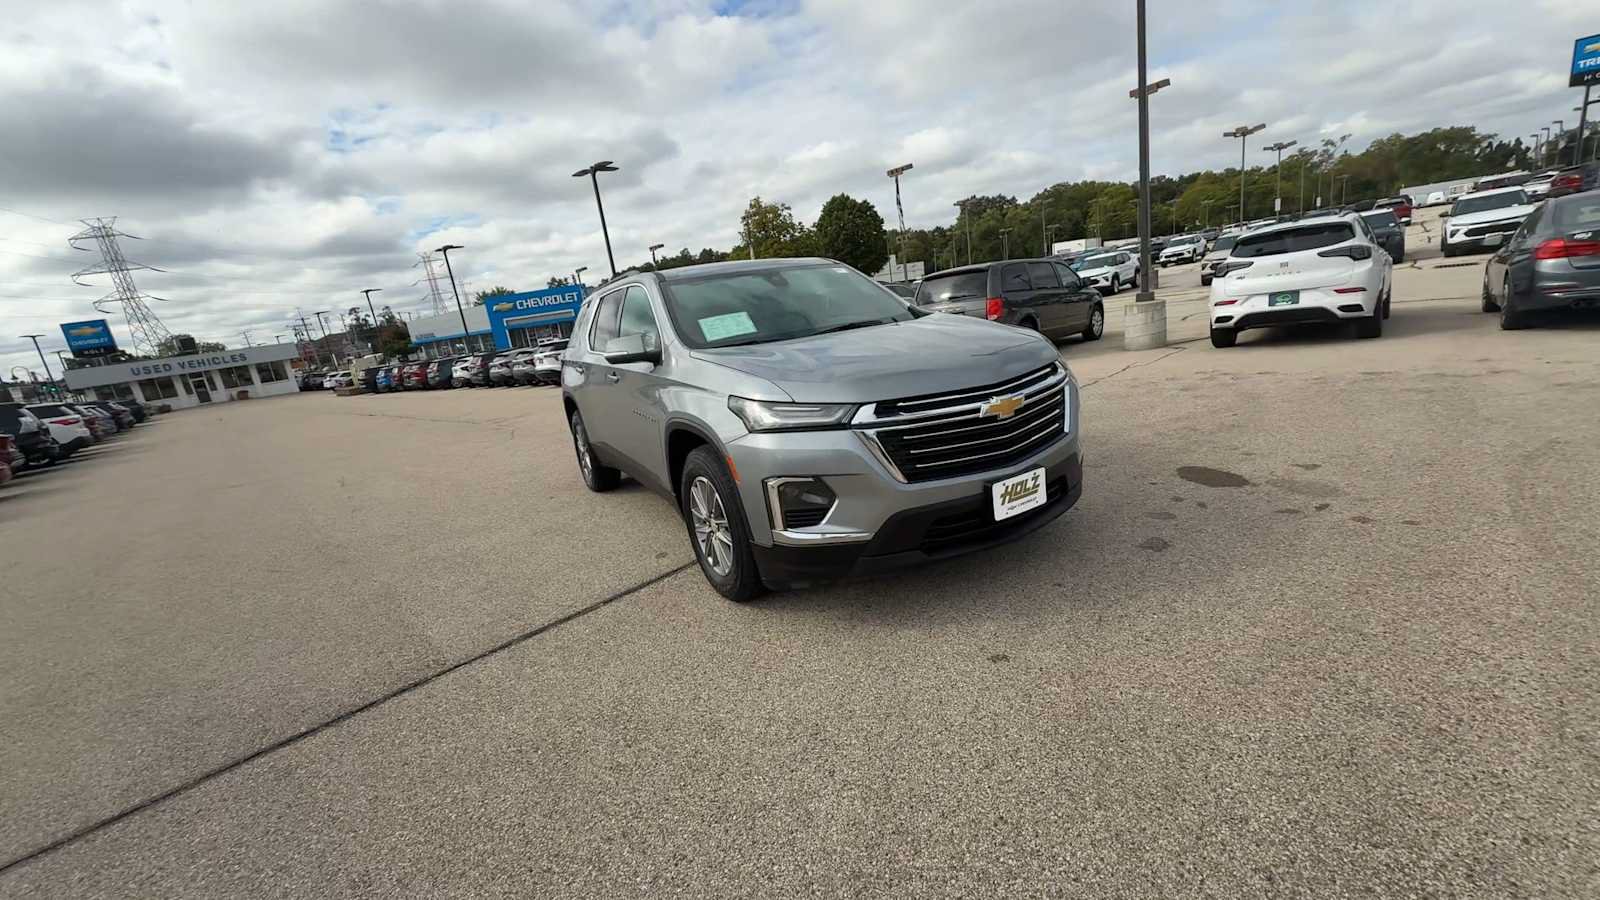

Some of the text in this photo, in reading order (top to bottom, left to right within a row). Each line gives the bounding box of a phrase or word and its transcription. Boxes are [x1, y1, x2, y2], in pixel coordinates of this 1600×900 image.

[516, 292, 579, 310] CHEVROLET
[130, 353, 248, 376] USED VEHICLES
